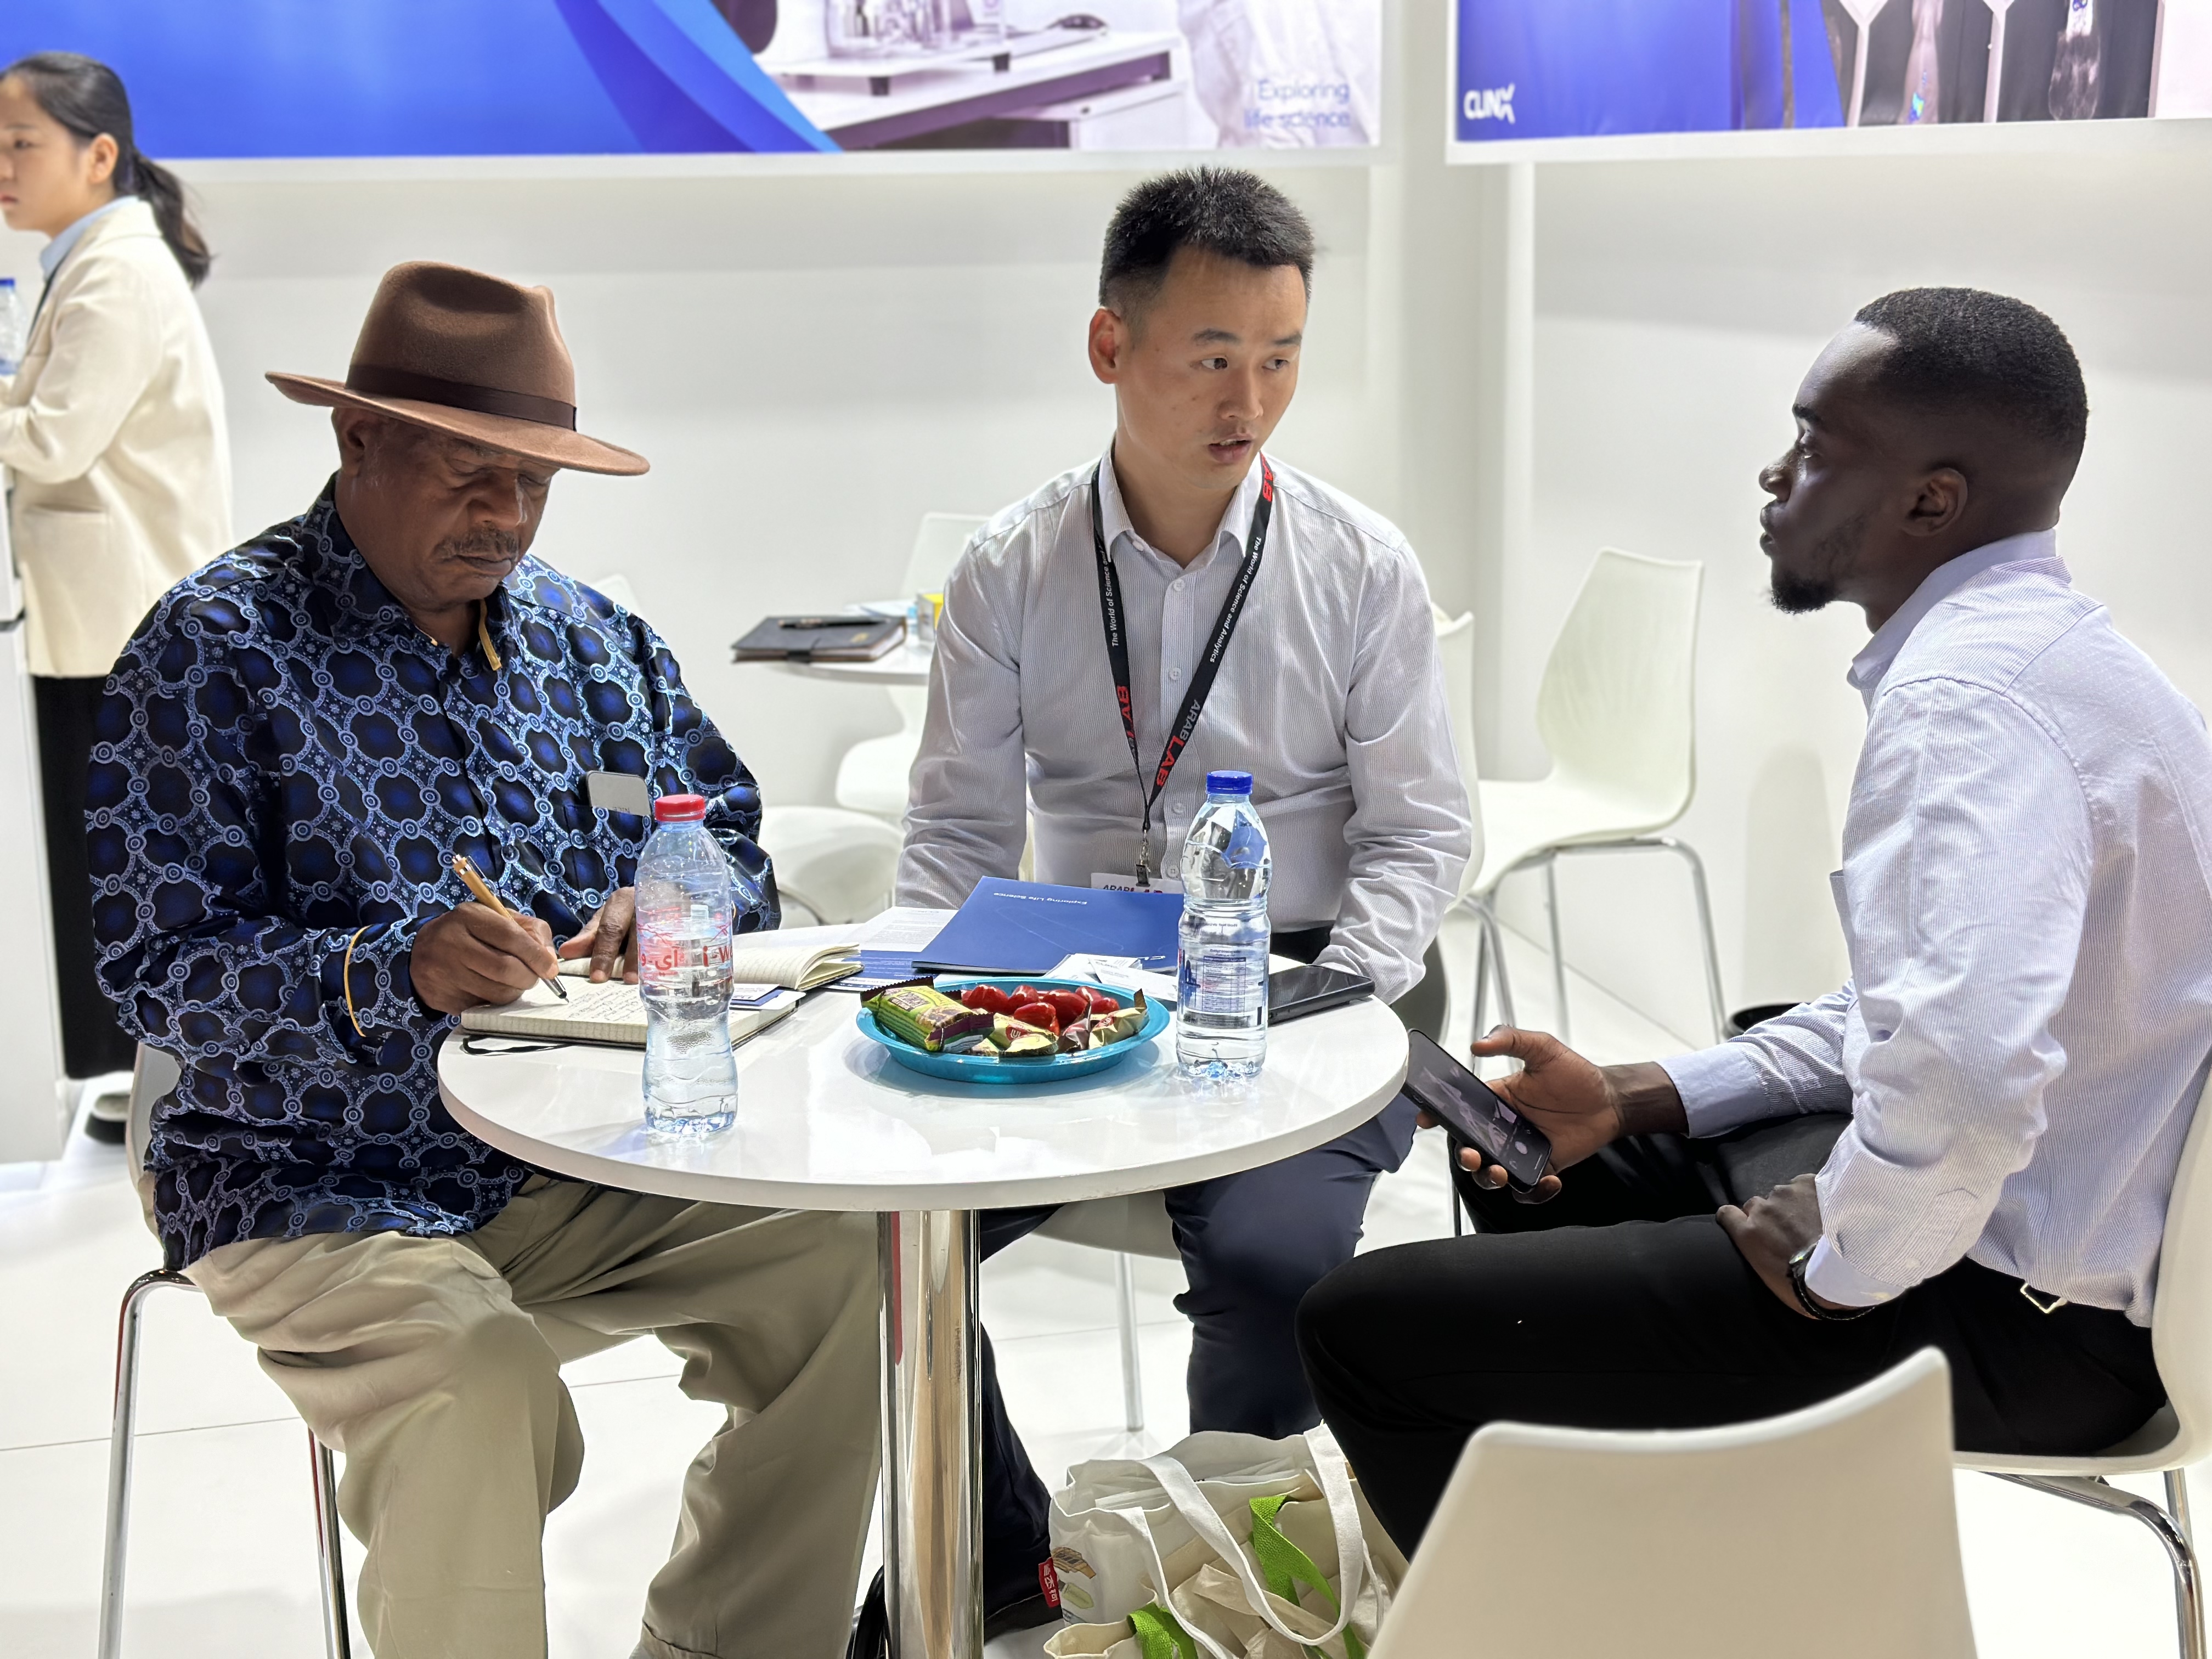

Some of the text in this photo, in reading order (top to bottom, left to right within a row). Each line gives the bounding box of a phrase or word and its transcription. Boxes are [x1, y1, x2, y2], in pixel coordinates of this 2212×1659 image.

[1259, 78, 1350, 105] Exploring
[1104, 566, 1113, 597] Science
[1107, 597, 1114, 607] of
[1210, 537, 1262, 663] The World of Science and Analytics
[1108, 608, 1116, 631] World
[1046, 897, 1087, 905] Exploring
